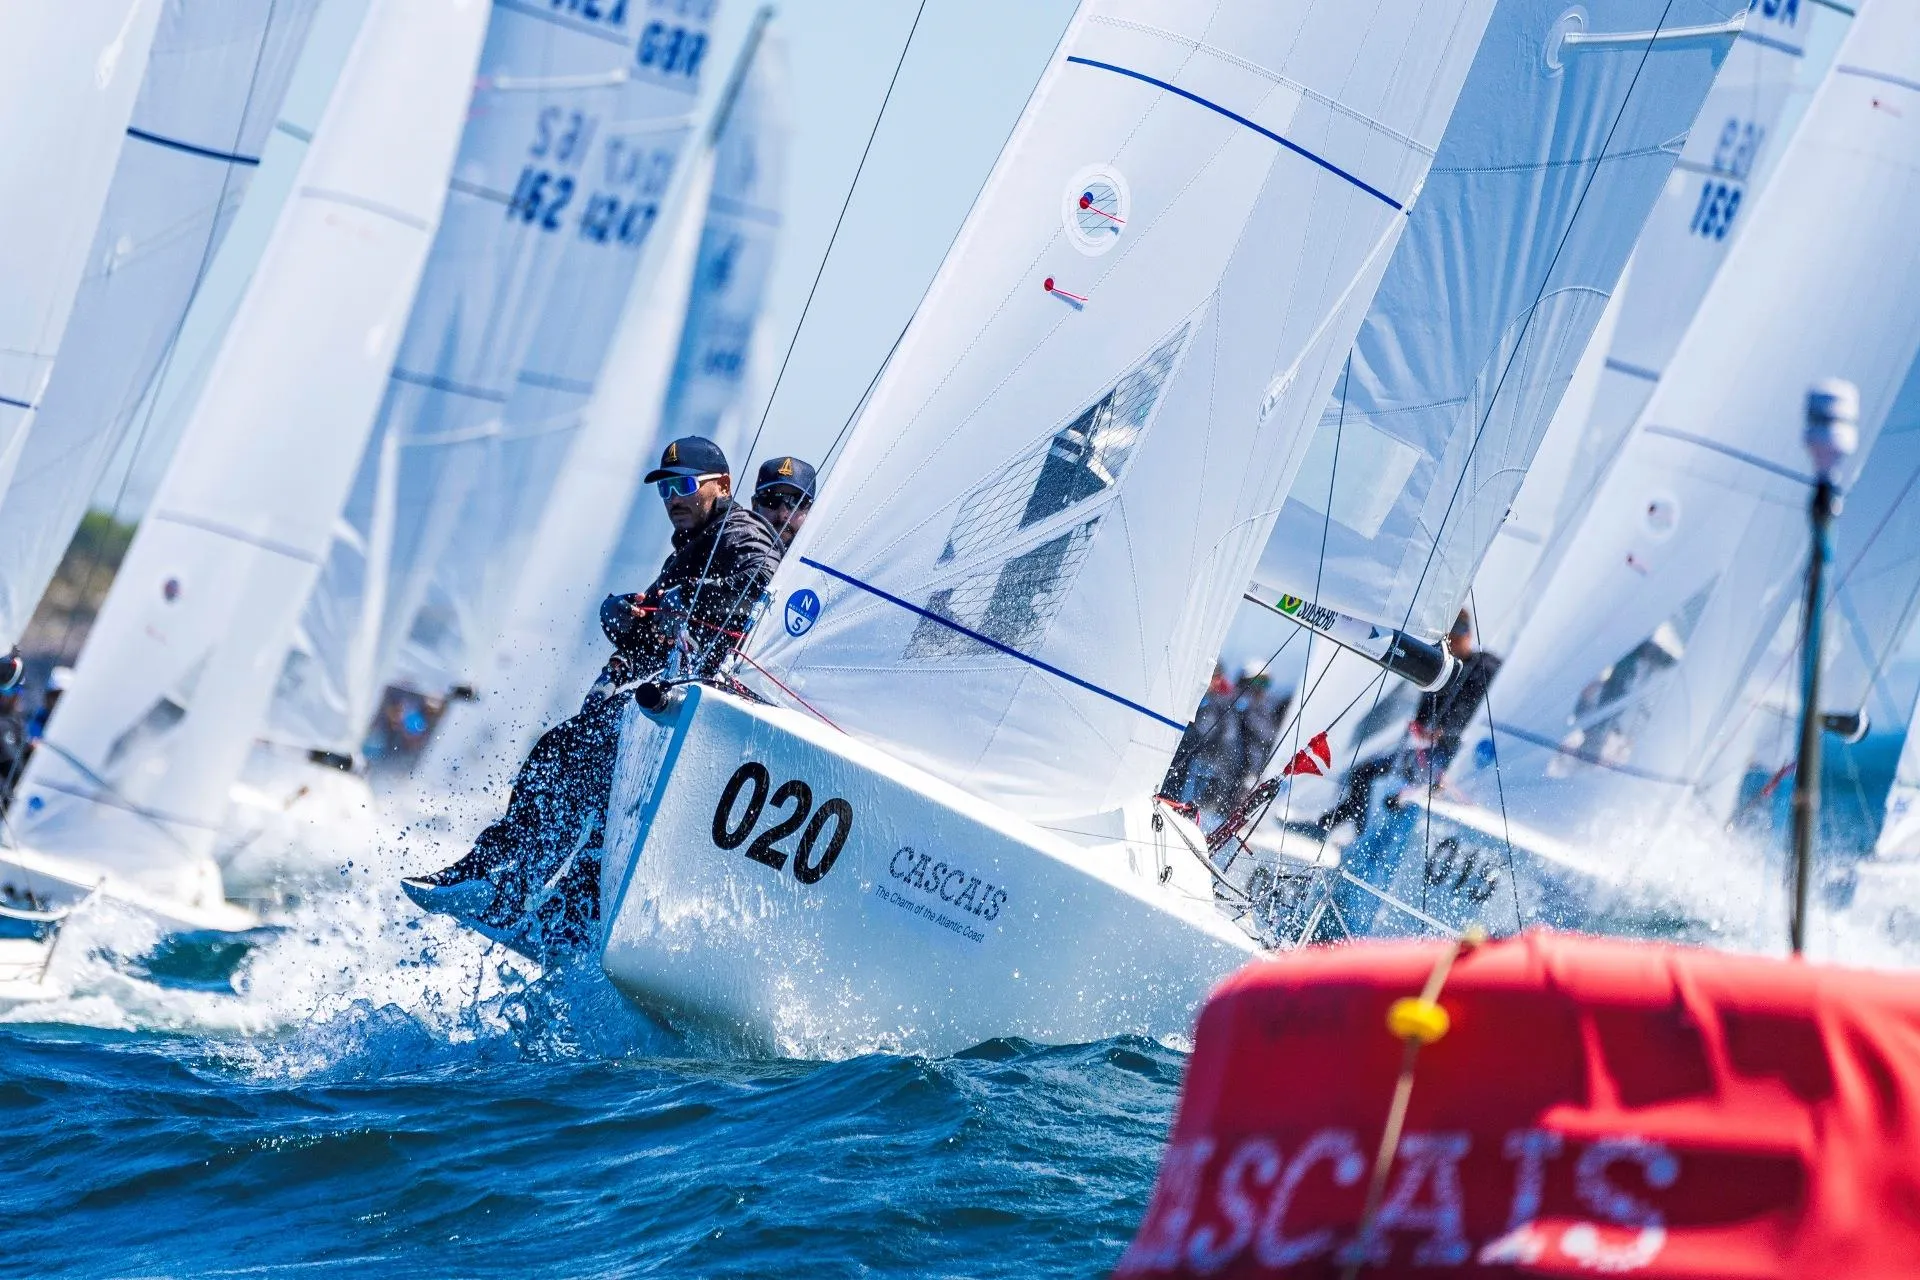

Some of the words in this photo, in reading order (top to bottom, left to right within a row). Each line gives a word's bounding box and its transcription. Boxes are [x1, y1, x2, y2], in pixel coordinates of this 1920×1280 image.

[712, 762, 853, 885] 020
[875, 885, 889, 900] The
[890, 892, 913, 912] Charm
[914, 904, 925, 914] of
[923, 907, 936, 921] the
[936, 913, 962, 933] Atlantic
[962, 926, 985, 943] Coast
[889, 846, 1007, 921] CASCAIS
